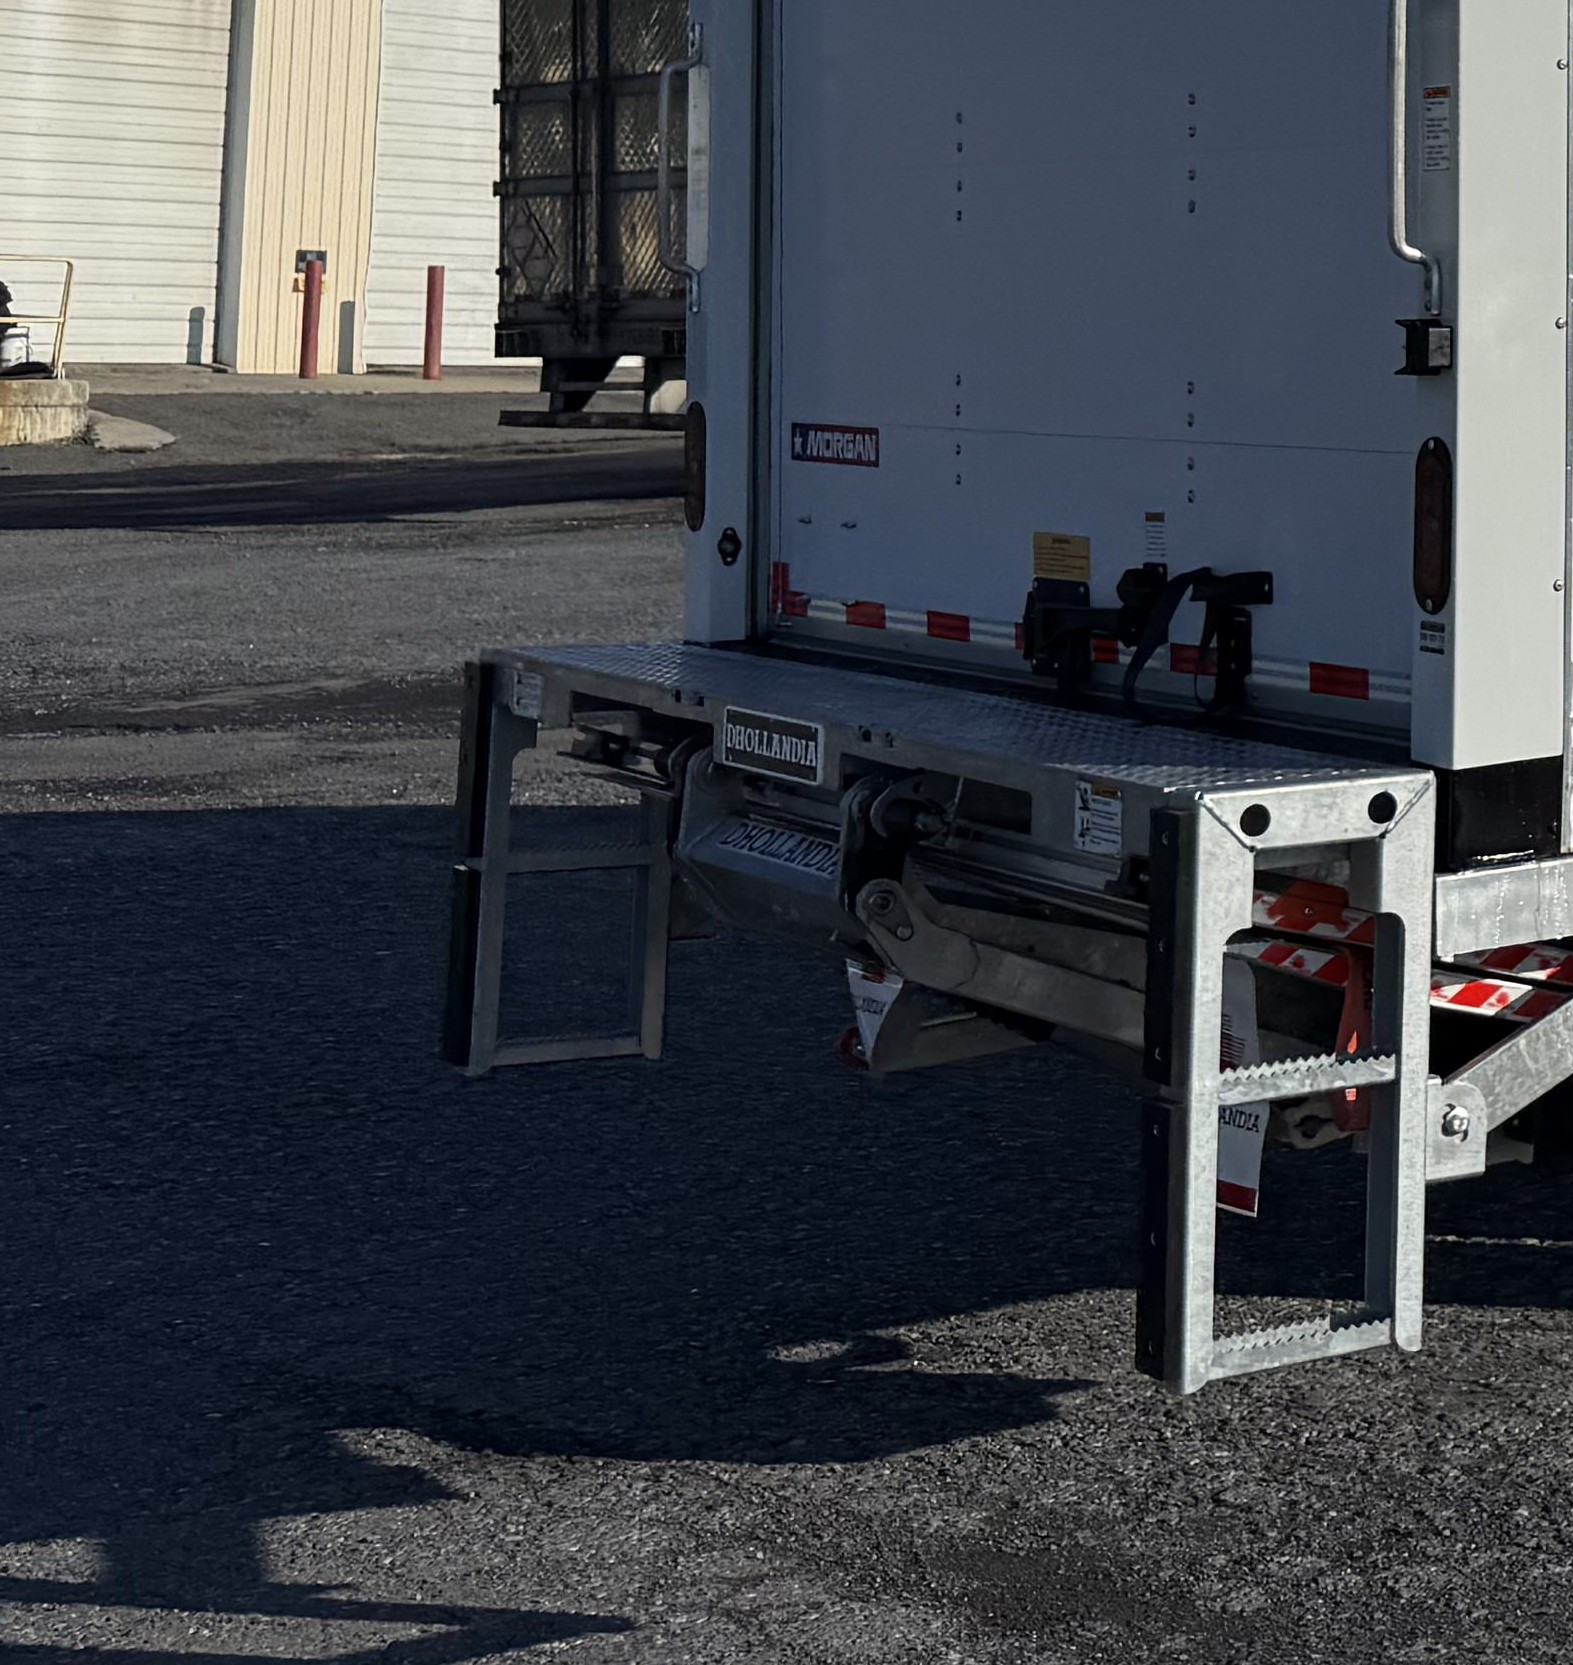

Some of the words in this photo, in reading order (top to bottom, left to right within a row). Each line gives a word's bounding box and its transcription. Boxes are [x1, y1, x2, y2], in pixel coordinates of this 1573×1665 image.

[806, 429, 877, 462] MORGAN
[726, 723, 818, 767] DHOLLANDIA
[719, 823, 841, 875] DHOLLANDI
